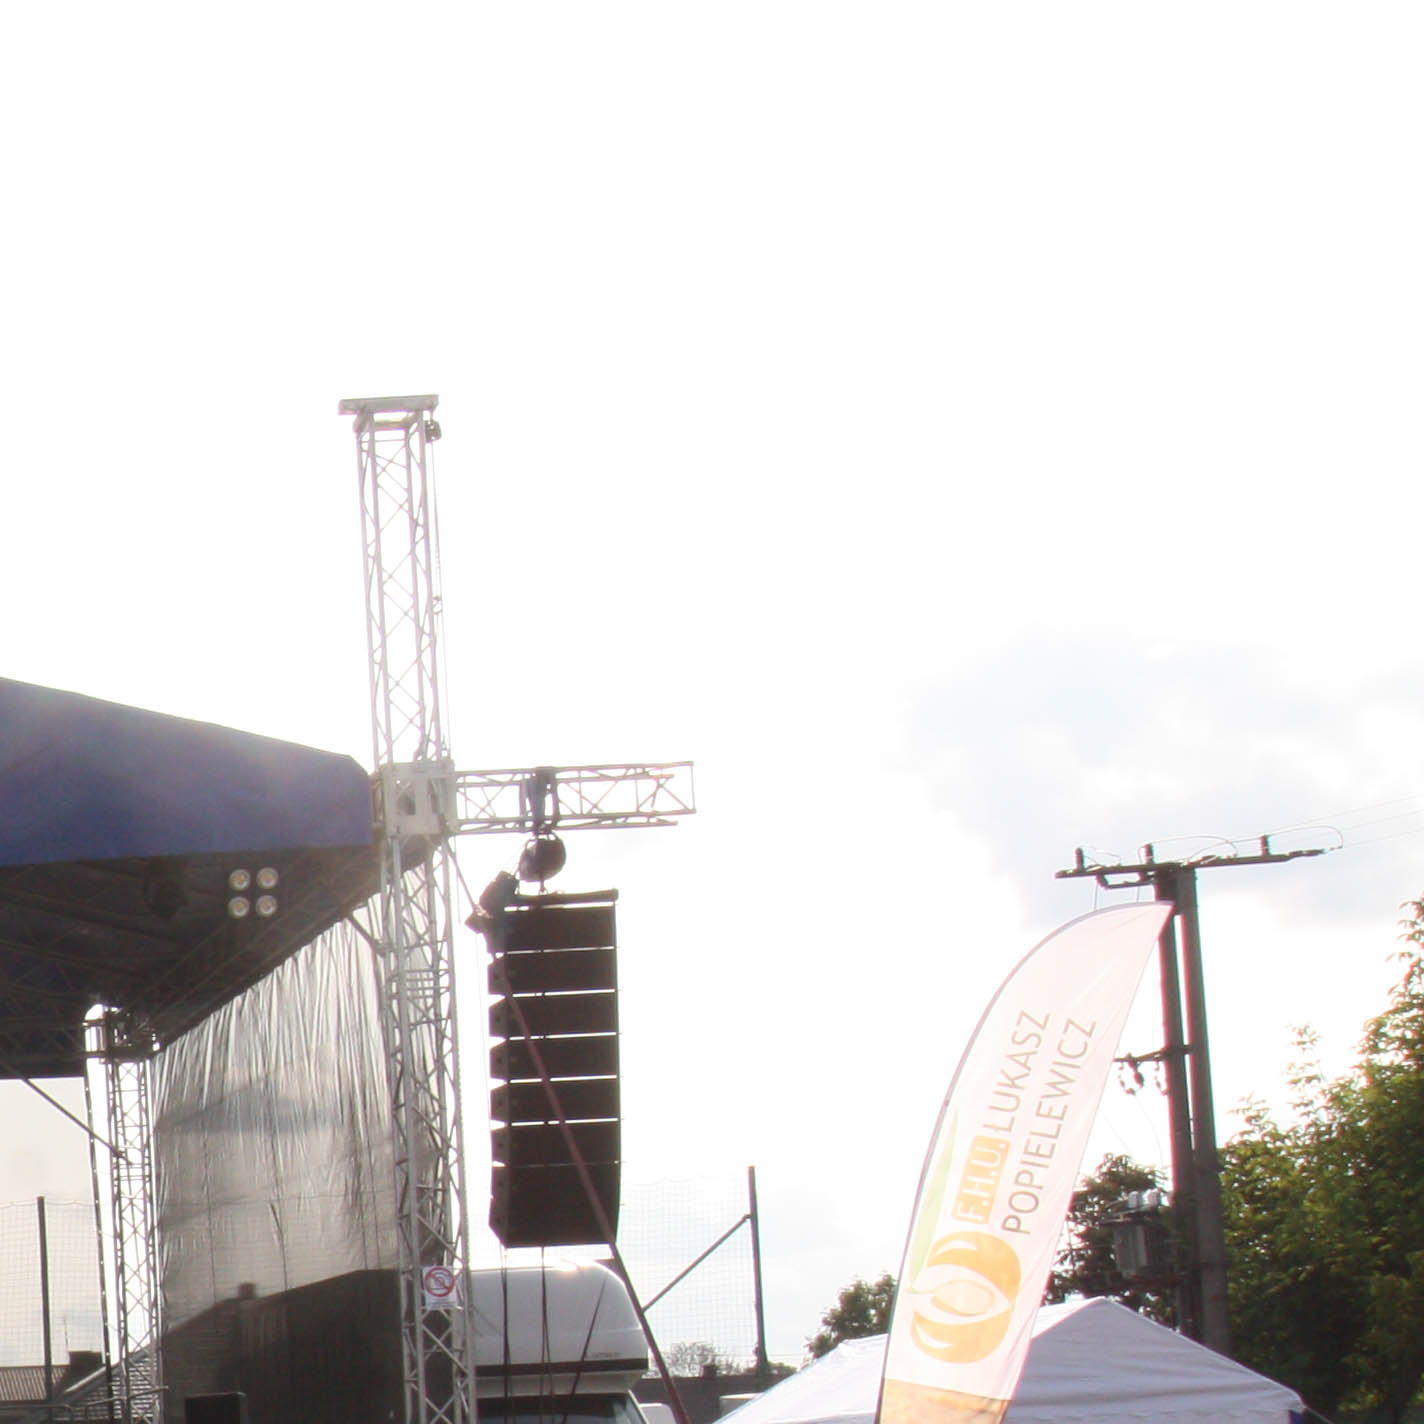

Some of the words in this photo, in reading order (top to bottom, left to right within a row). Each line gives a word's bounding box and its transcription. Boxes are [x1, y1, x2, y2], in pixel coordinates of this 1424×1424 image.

[957, 1142, 1007, 1222] F.H.U.
[983, 1009, 1050, 1133] ŁUKASZ
[1001, 1018, 1097, 1235] POPIELEWICZ
